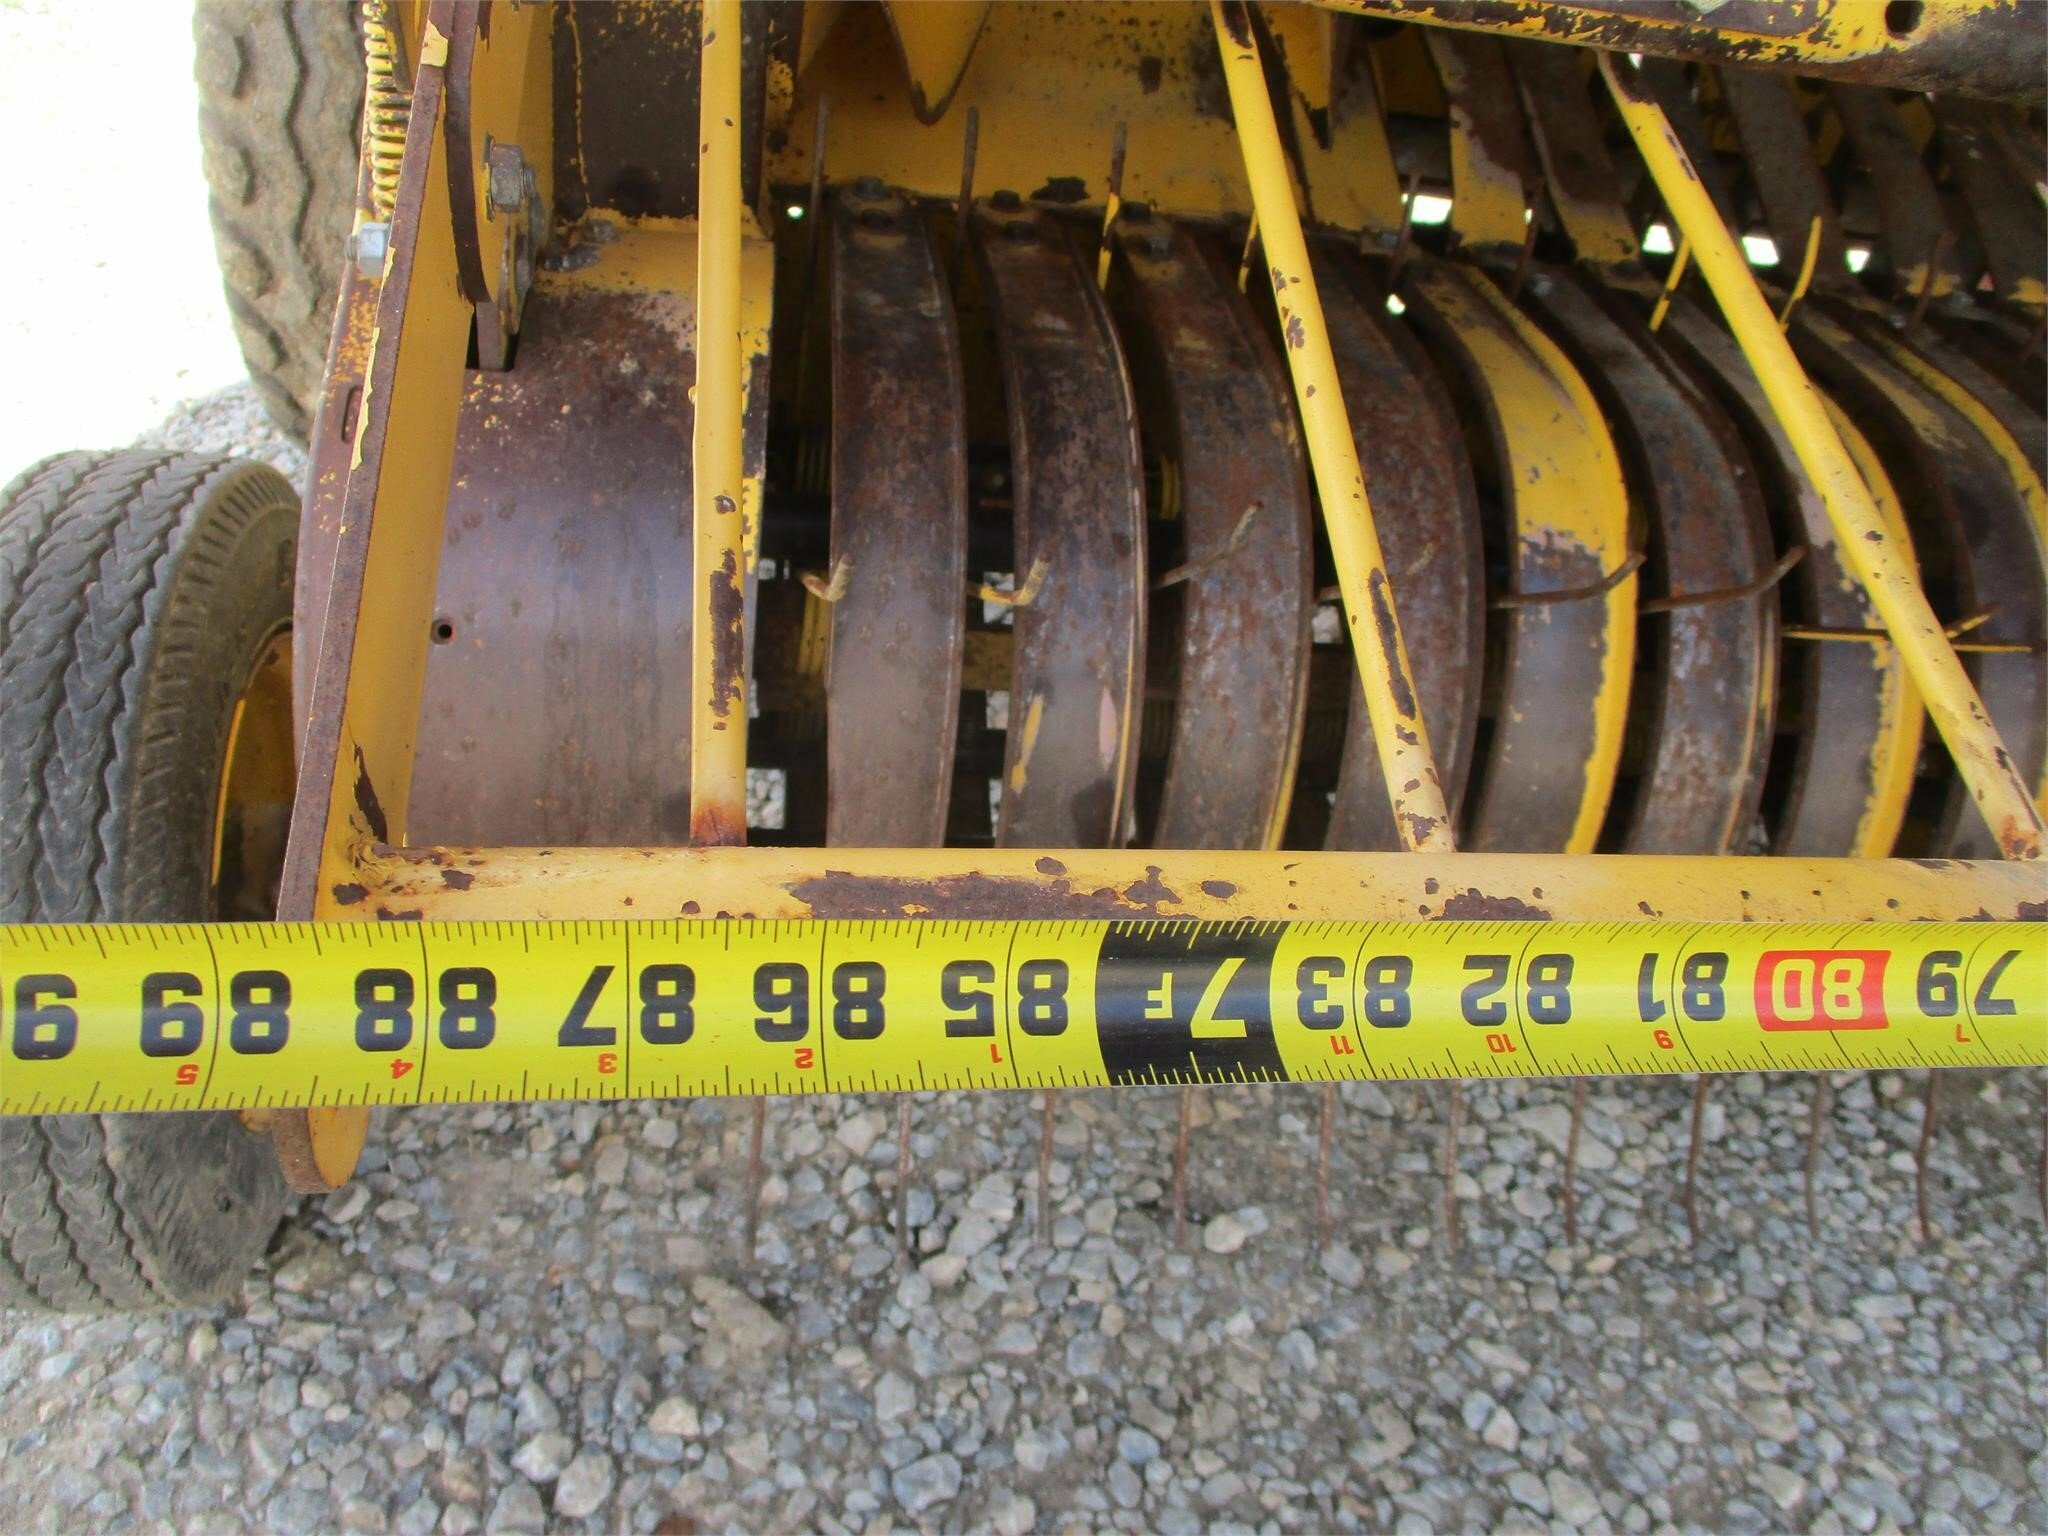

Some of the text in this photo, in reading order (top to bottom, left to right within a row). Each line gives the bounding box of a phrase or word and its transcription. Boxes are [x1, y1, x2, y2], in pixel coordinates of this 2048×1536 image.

[0, 973, 77, 1061] 9
[140, 970, 292, 1058] 89
[354, 967, 497, 1052] 88
[558, 963, 696, 1047] 87
[753, 960, 886, 1042] 86
[940, 959, 1070, 1038] 85
[1296, 955, 1413, 1030] 83
[1461, 953, 1575, 1027] 82
[1638, 952, 1729, 1022] 81
[1772, 957, 1864, 1021] 80
[1916, 950, 2021, 1018] 79
[175, 1023, 1970, 1086] 7 9 10 11 1 2 3 4 5
